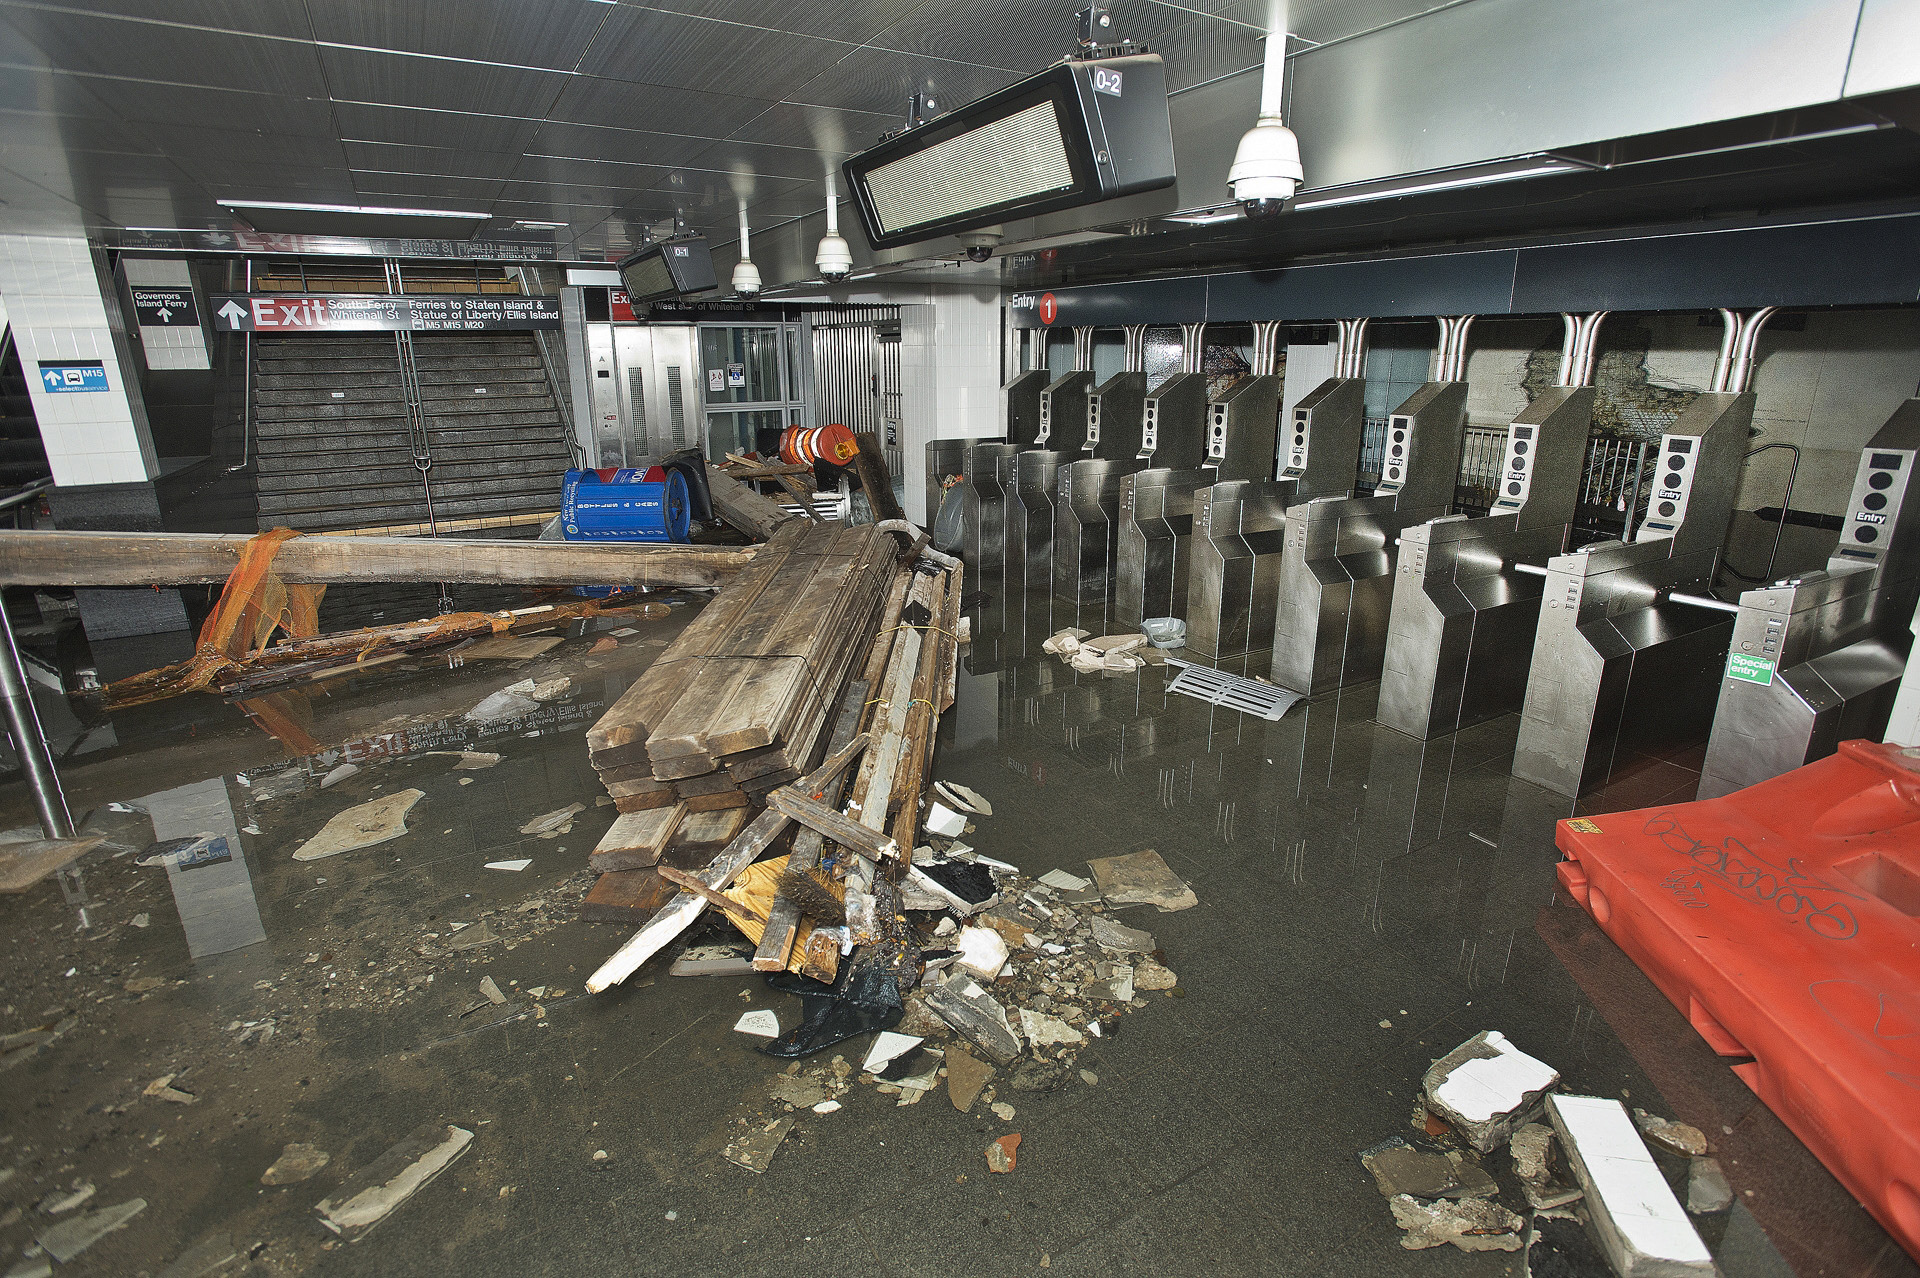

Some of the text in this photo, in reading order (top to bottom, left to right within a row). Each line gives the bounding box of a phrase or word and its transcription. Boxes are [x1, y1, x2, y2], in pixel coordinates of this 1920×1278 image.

[1096, 70, 1120, 94] 0-2
[675, 248, 687, 256] 0-1
[135, 292, 181, 300] Governors
[611, 292, 631, 304] Exi
[164, 300, 188, 309] Ferry
[327, 300, 397, 311] South Ferry
[408, 300, 544, 310] Ferries to Staten Island &
[655, 302, 676, 310] West
[697, 302, 706, 311] of
[708, 302, 744, 311] Whitehall
[745, 303, 755, 311] St
[1012, 293, 1051, 319] Entry 1
[251, 299, 328, 326] Exit
[329, 310, 400, 320] Whitehall St
[410, 310, 559, 321] Statue of Liberty/Ellis Island
[426, 321, 485, 329] M5 M15 M20
[82, 369, 104, 378] M15
[1509, 472, 1526, 481] Entry
[1660, 490, 1681, 500] Entry
[1857, 512, 1886, 524] Entry
[1733, 655, 1773, 671] Special
[1731, 665, 1759, 678] entry
